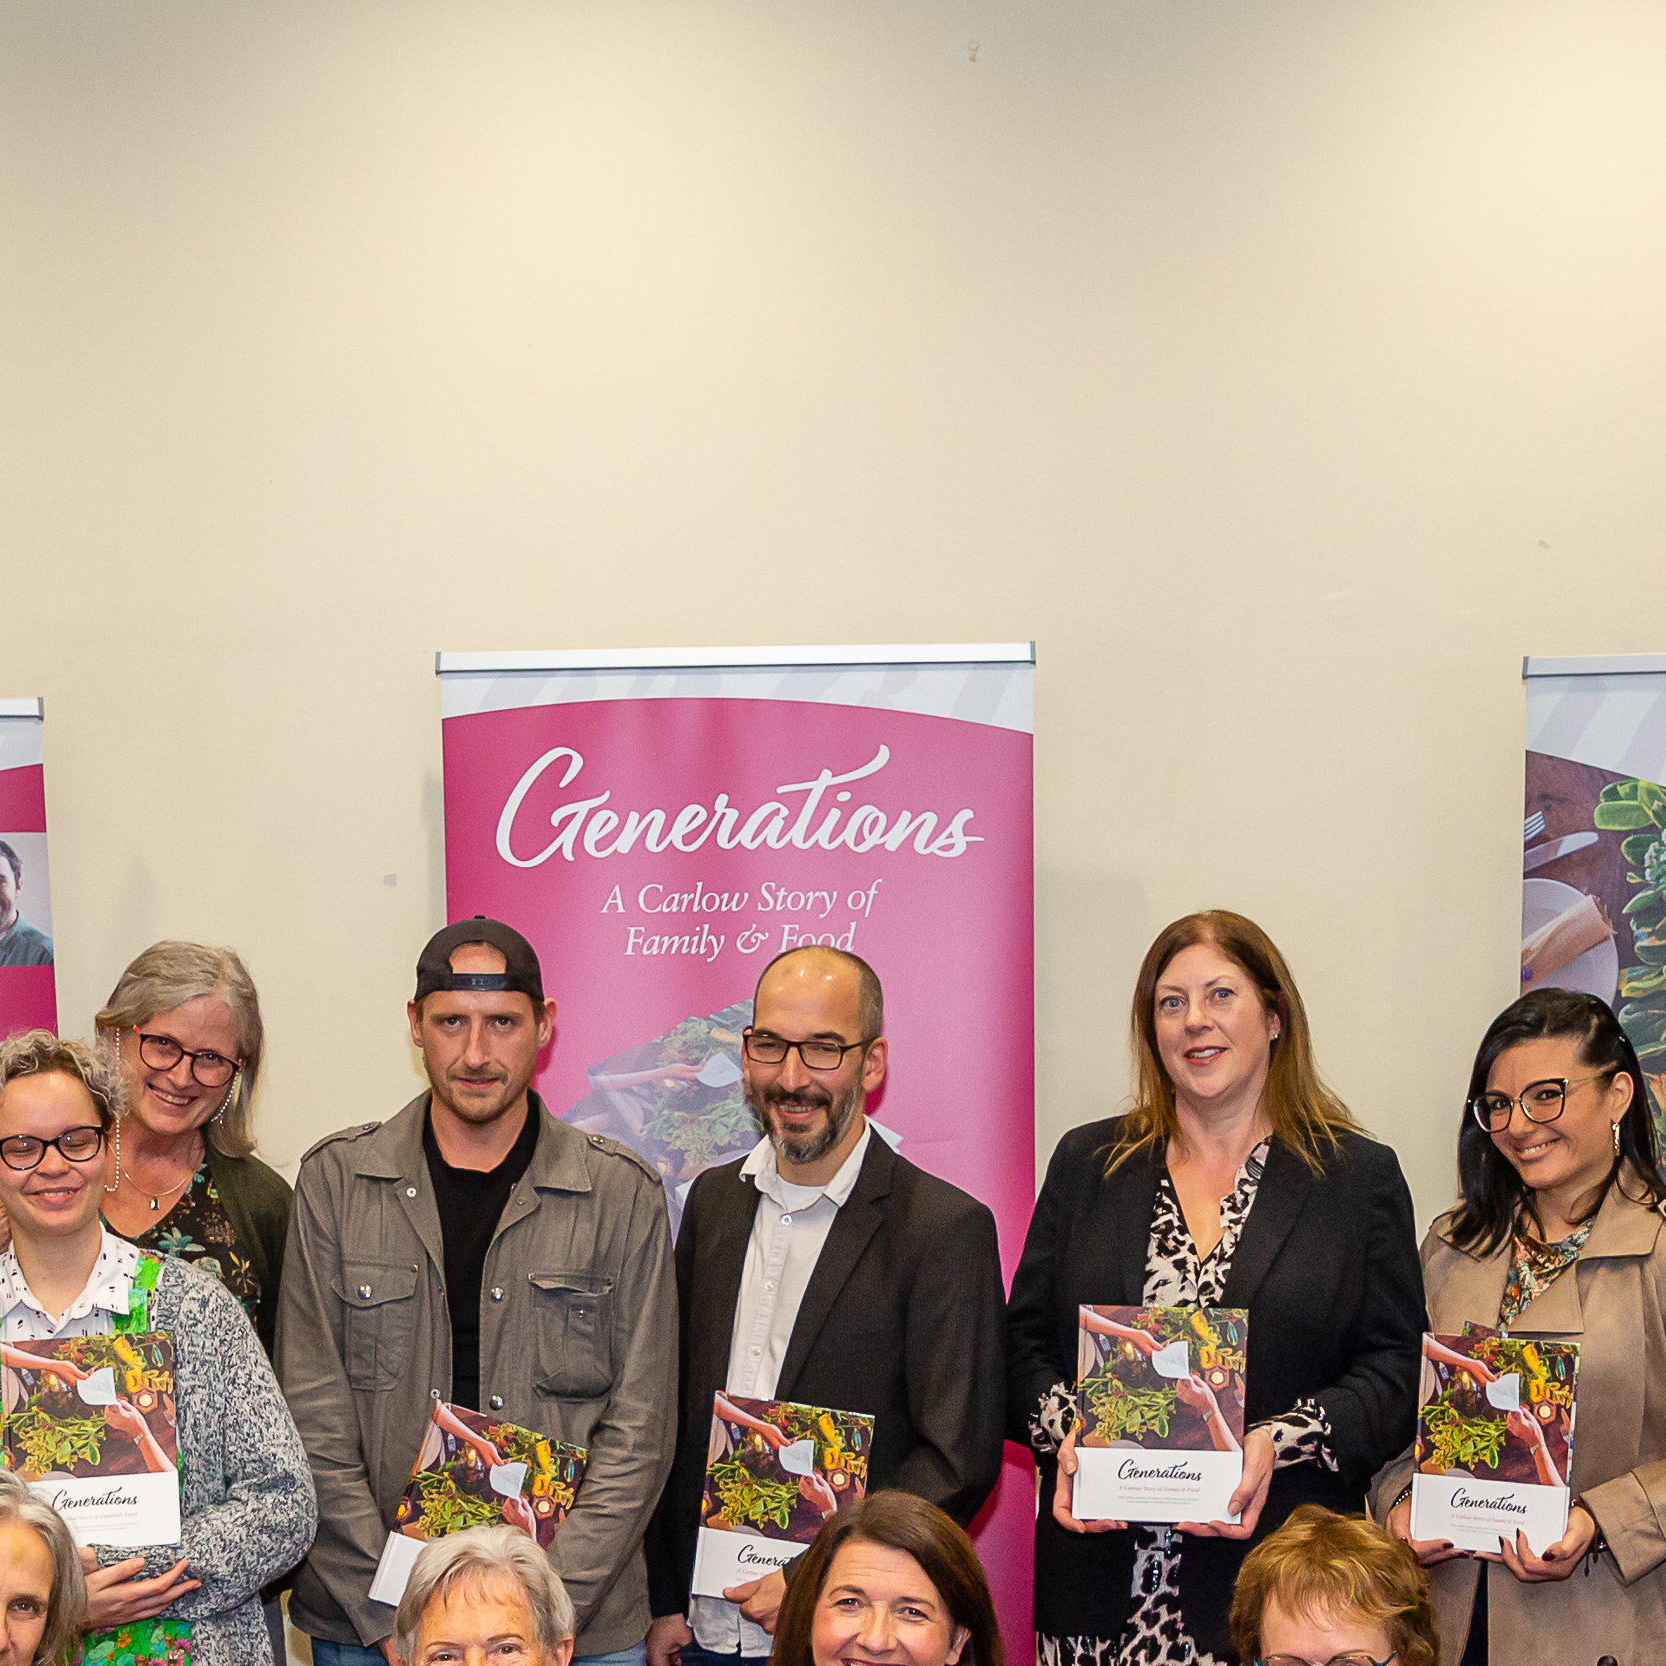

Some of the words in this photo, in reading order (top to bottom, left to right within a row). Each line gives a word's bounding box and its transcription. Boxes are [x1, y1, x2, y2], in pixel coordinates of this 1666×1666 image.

[495, 745, 984, 868] Generations
[602, 884, 625, 914] A
[638, 881, 748, 915] Carlow
[757, 881, 837, 915] Story
[847, 879, 882, 918] of
[625, 925, 725, 962] Family
[736, 925, 768, 954] &
[778, 922, 854, 953] Food
[1118, 1459, 1202, 1481] Generations
[52, 1487, 139, 1511] Generations
[1451, 1488, 1527, 1514] Generations
